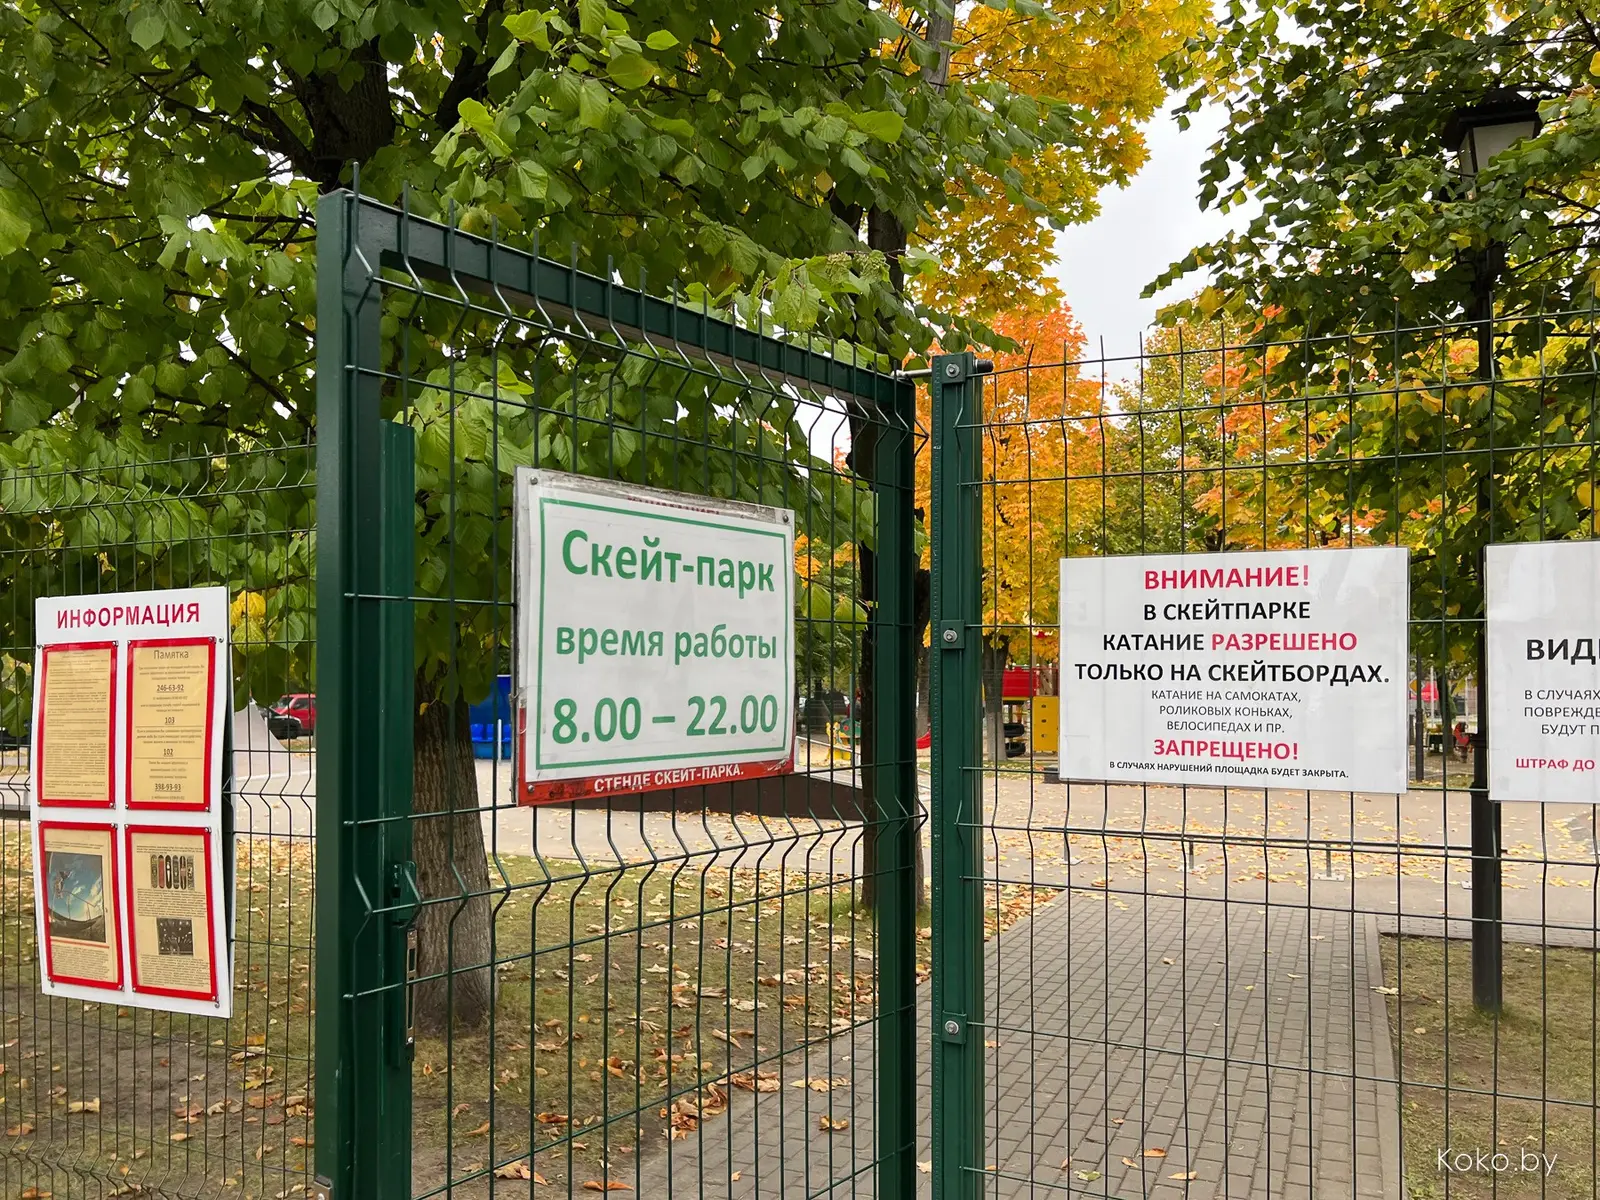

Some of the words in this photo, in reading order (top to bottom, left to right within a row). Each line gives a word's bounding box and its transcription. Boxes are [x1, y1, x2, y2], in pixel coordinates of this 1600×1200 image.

[562, 529, 775, 599] Скейт-парк
[1145, 565, 1309, 590] ВНИМАНИЕ!
[57, 602, 200, 629] ИНФОРМАЦИЯ
[1144, 604, 1157, 621] В
[1163, 598, 1311, 621] СКЕЙТПАРКЕ
[556, 627, 664, 664] время
[675, 624, 777, 665] работы
[1103, 633, 1205, 651] КАТАНИЕ
[1212, 632, 1357, 651] РАЗРЕШЕНО
[153, 649, 189, 660] Памятка
[1526, 638, 1600, 666] ВИД
[1074, 663, 1164, 681] ТОЛЬКО
[1170, 664, 1202, 681] НА
[1208, 660, 1390, 687] СКЕЙТБОРДАХ.
[1151, 689, 1203, 700] КАТАНИЕ
[1206, 690, 1222, 700] НА
[1224, 690, 1302, 703] САМОКАТАХ,
[1524, 689, 1533, 700] В
[1536, 689, 1600, 701] СЛУЧАЯХ
[164, 716, 175, 725] 103
[552, 697, 642, 744] 8.00
[686, 695, 778, 736] 22.00
[1159, 705, 1232, 716] РОЛИКОВЫХ
[1234, 706, 1293, 719] КОНЬКАХ,
[1166, 720, 1251, 734] ВЕЛОСИПЕДАХ
[1254, 722, 1263, 733] И
[1266, 723, 1285, 733] ПР.
[1541, 724, 1587, 737] БУДУТ
[163, 748, 174, 757] 102
[1154, 739, 1298, 762] ЗАПРЕЩЕНО!
[1116, 761, 1156, 771] СЛУЧАЯХ
[1157, 763, 1213, 773] НАРУШЕНИЙ
[1214, 765, 1270, 776] ПЛОЩАДКА
[1271, 767, 1300, 778] БУДЕТ
[1302, 768, 1349, 778] ЗАКРЫТА.
[1516, 758, 1569, 769] ШТРАФ
[1573, 759, 1595, 772] ДО
